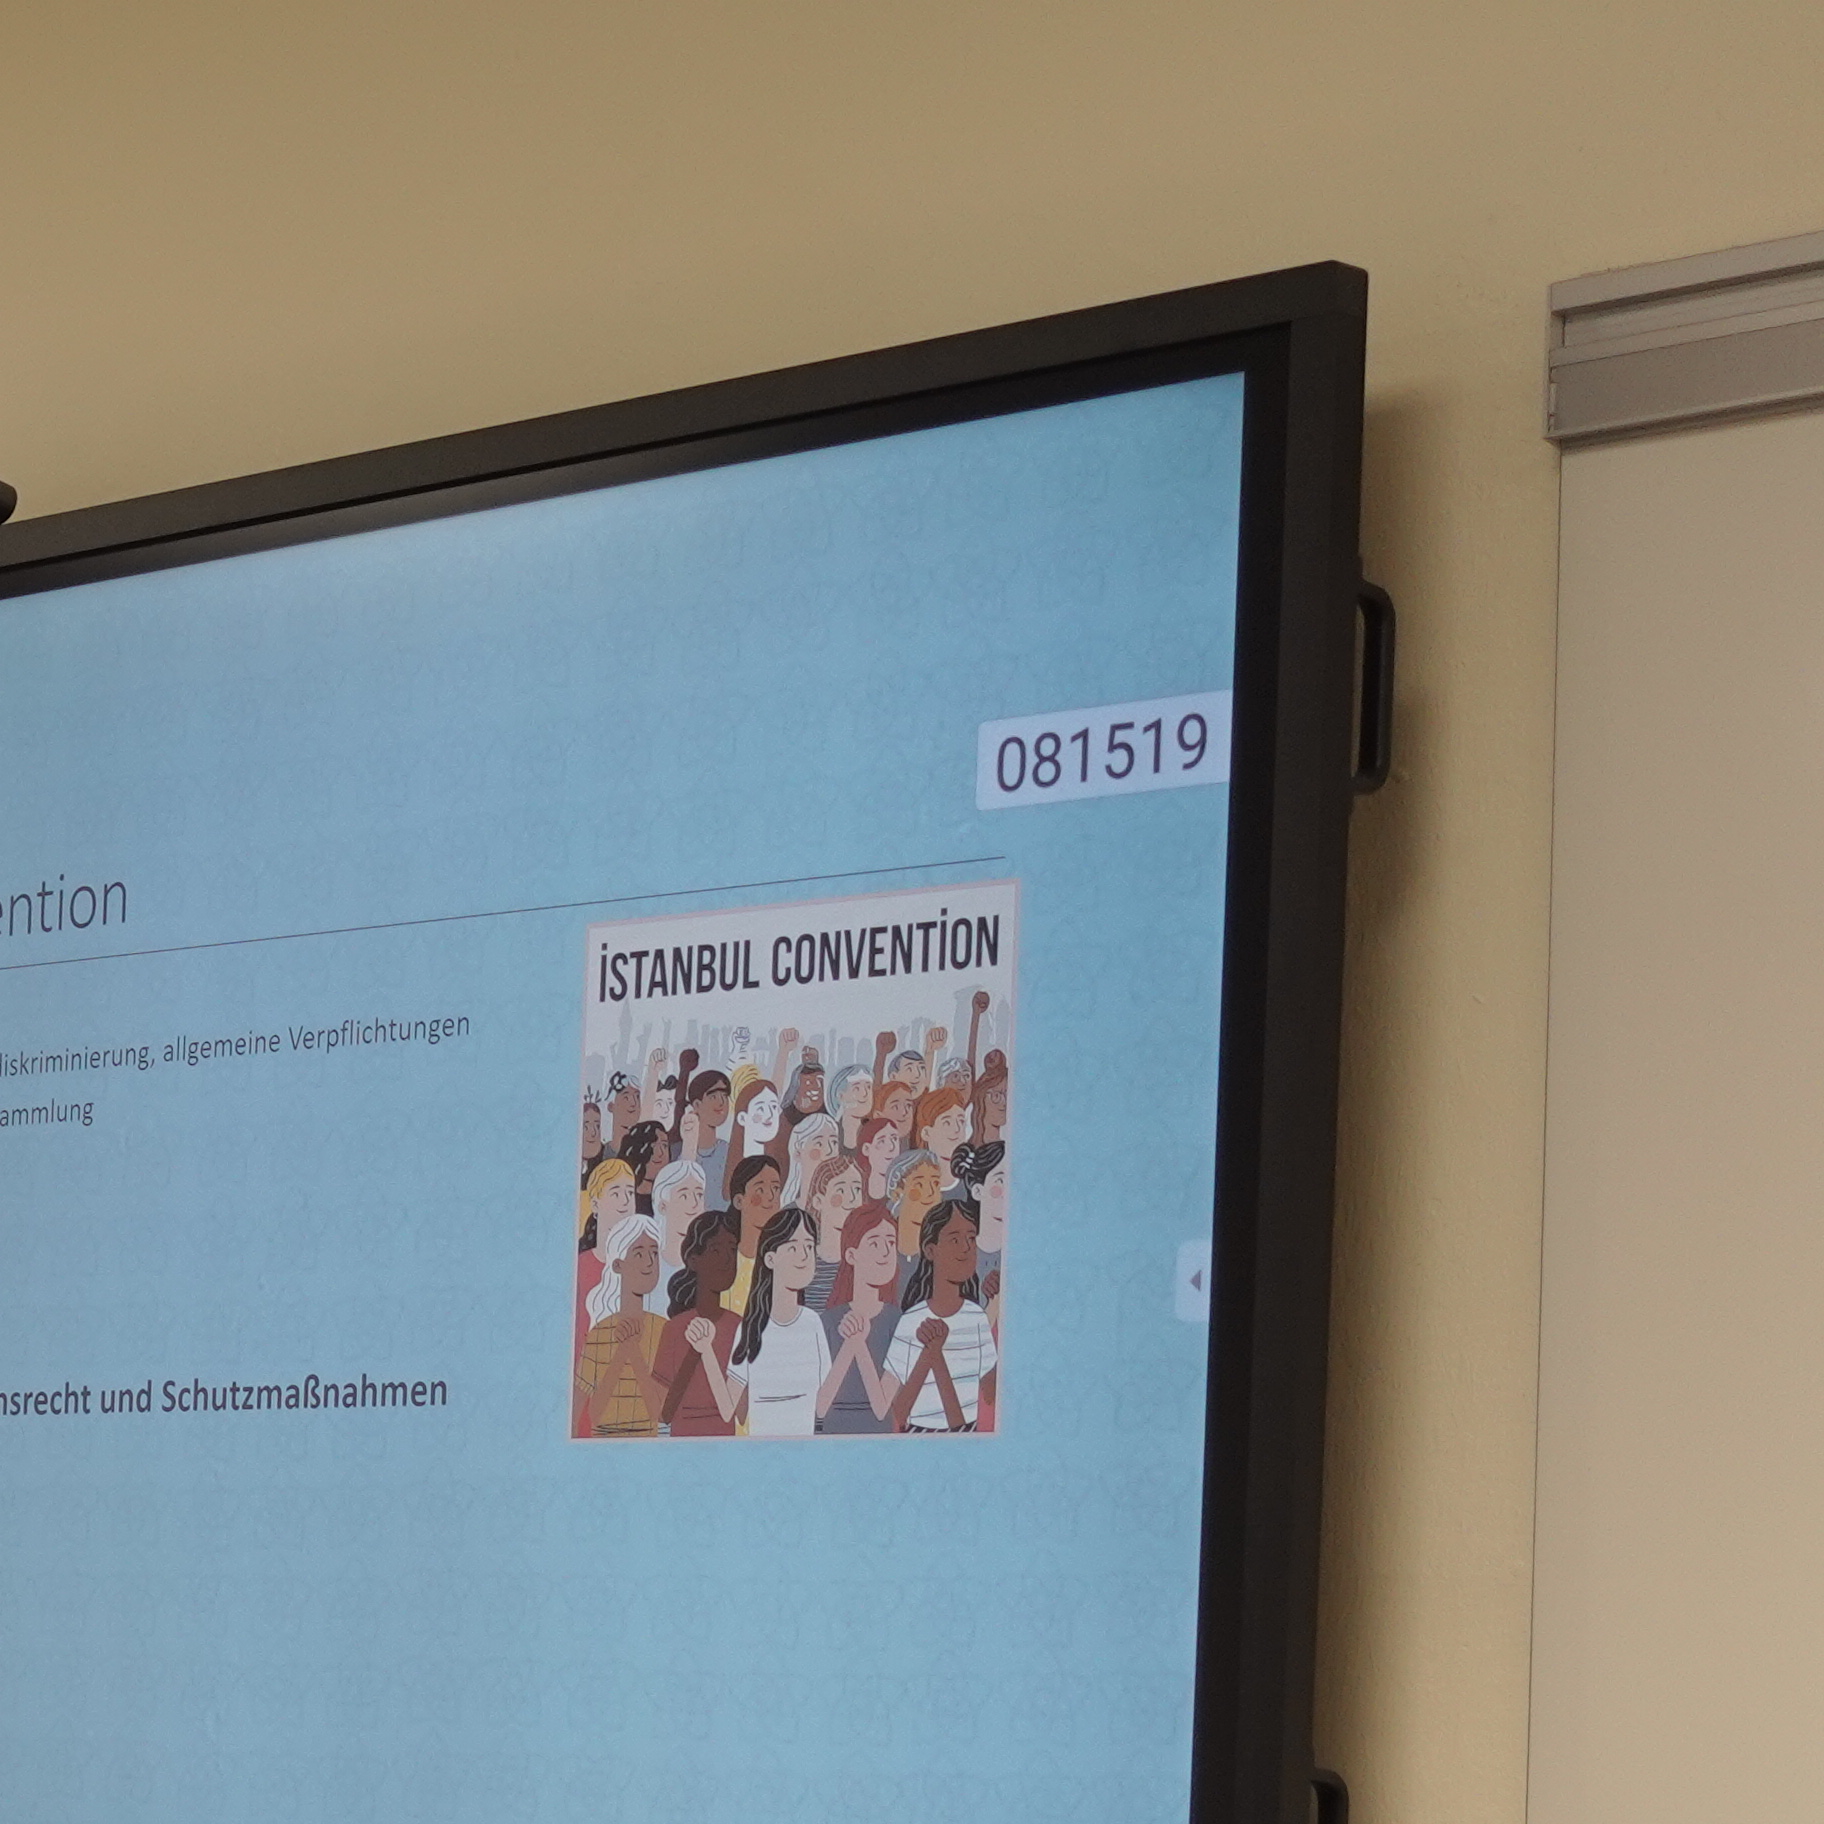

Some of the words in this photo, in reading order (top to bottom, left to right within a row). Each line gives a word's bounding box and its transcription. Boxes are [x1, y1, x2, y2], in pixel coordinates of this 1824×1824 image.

[996, 713, 1209, 794] 081519
[163, 1031, 280, 1066] allgemeine
[288, 1013, 470, 1056] Verpflichtungen
[101, 1380, 152, 1413] und
[162, 1372, 449, 1411] Schutzmaßnahmen
